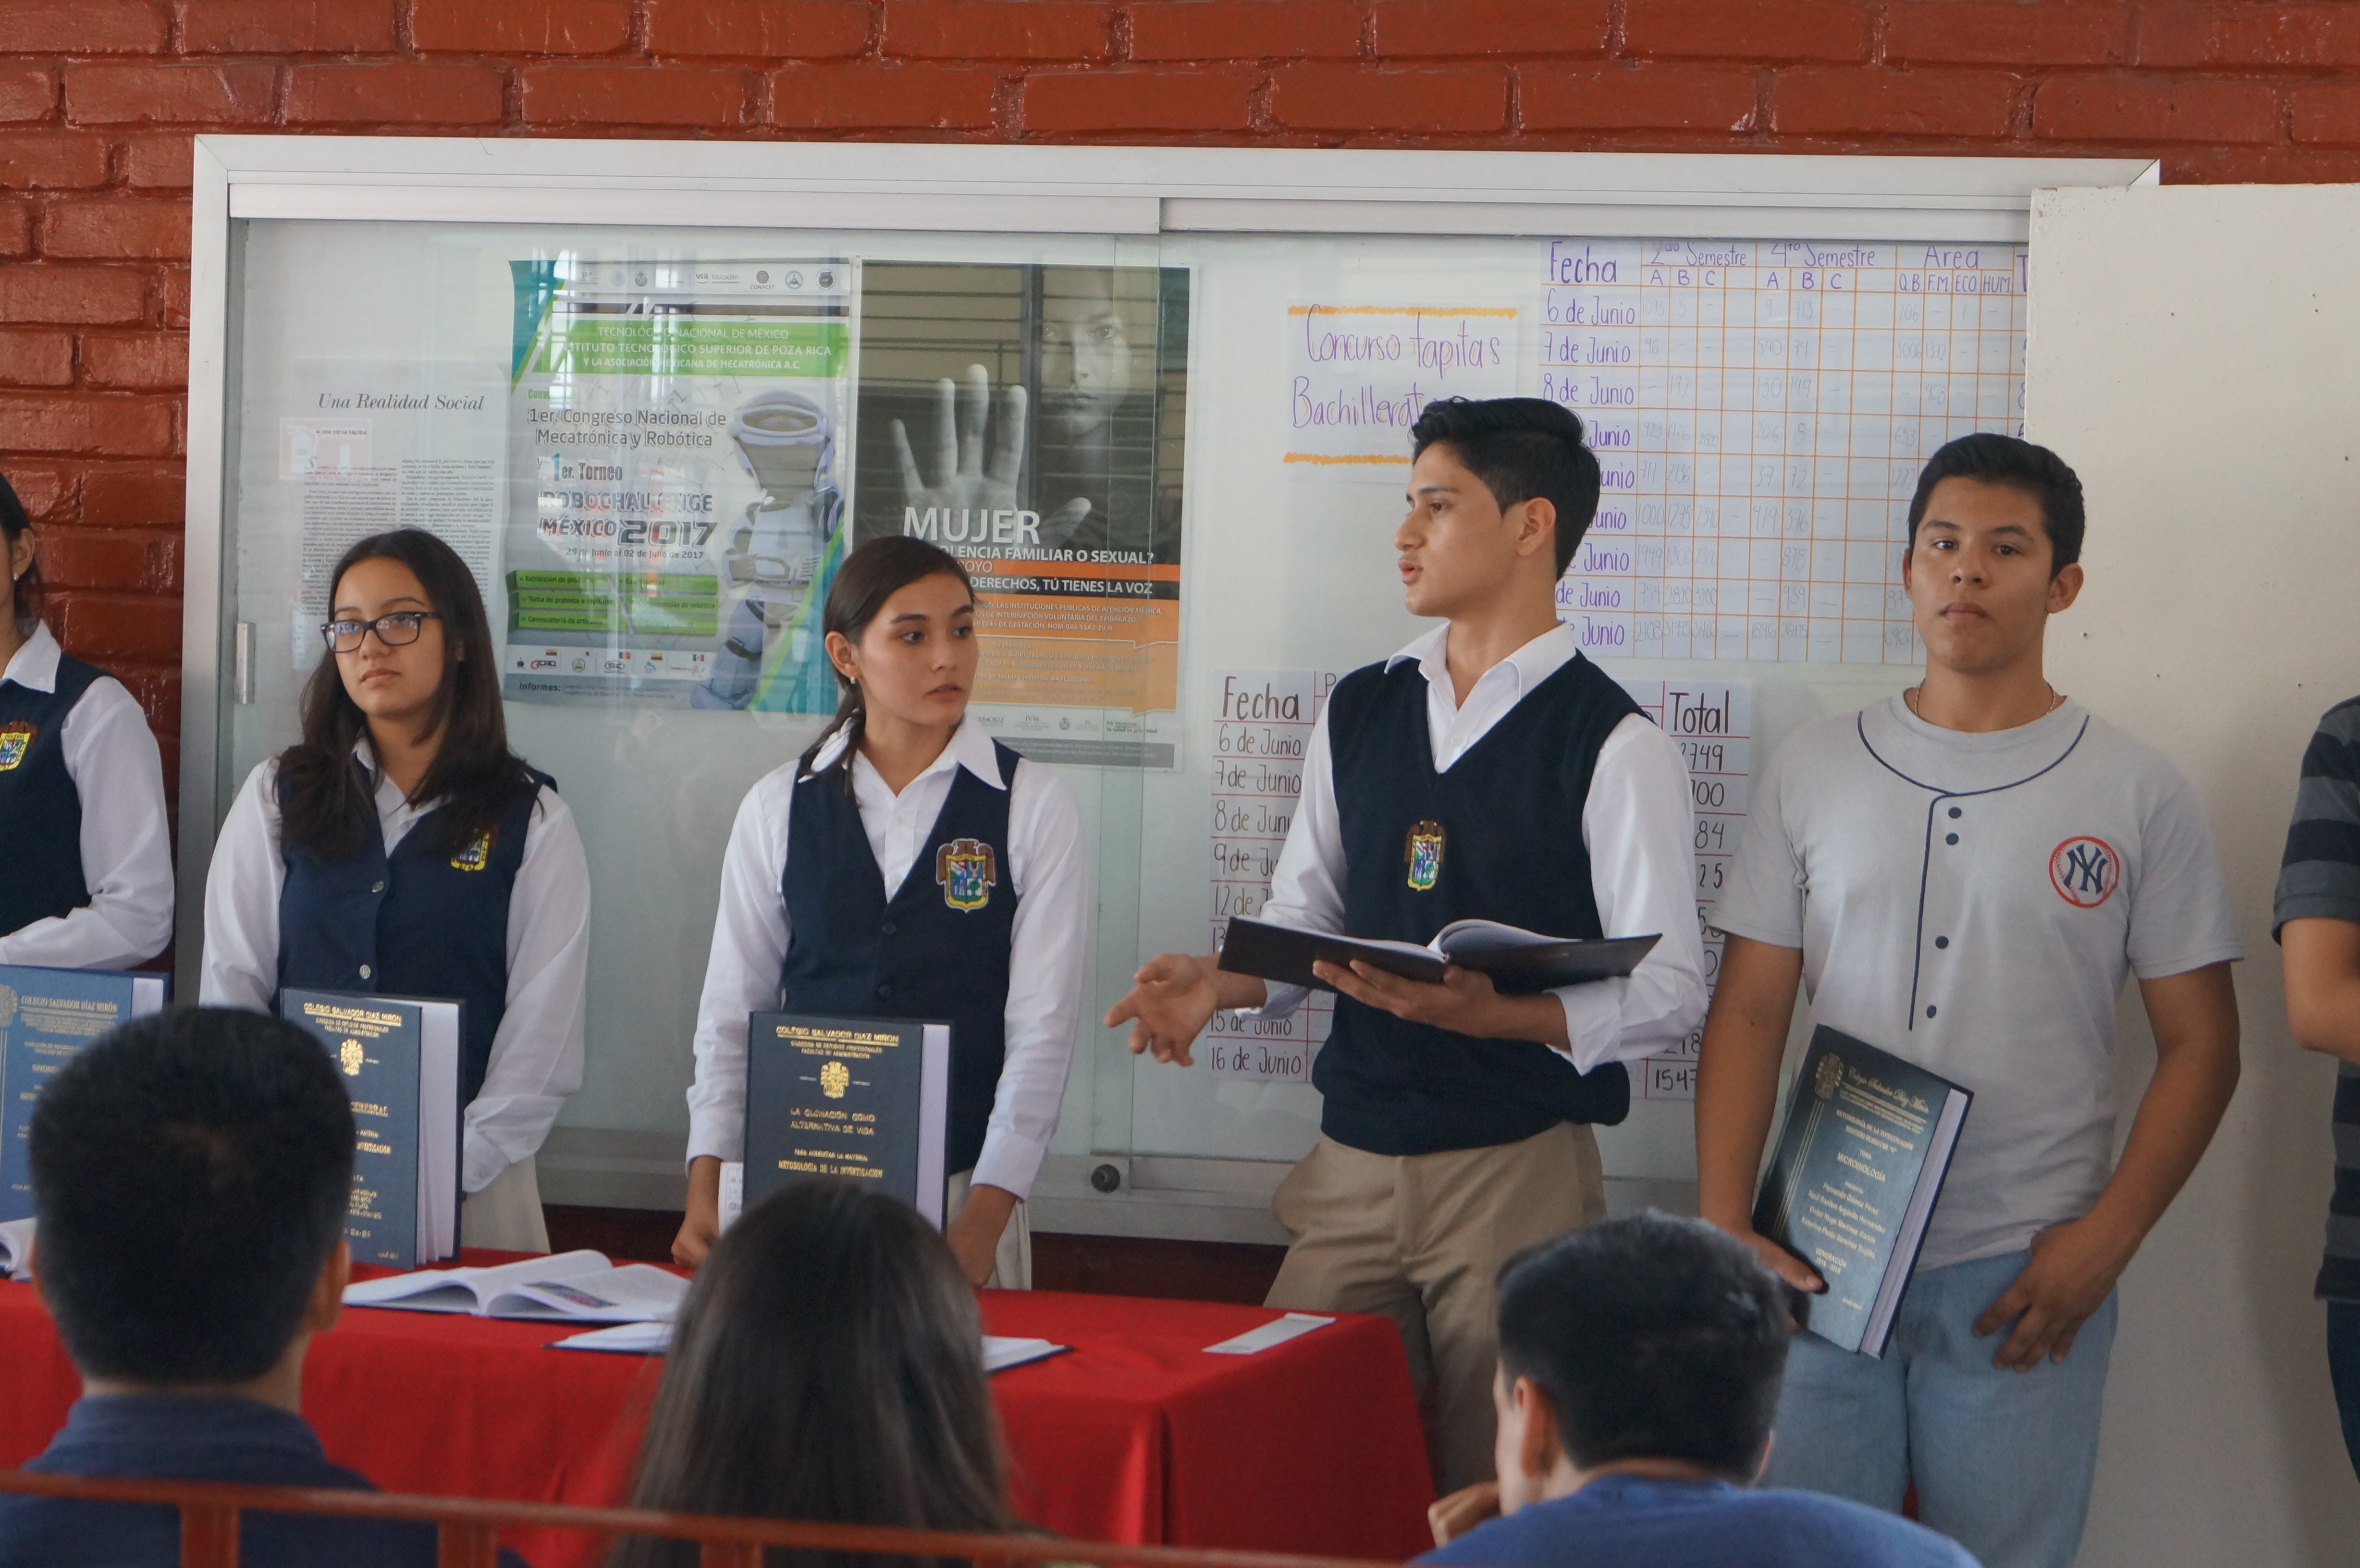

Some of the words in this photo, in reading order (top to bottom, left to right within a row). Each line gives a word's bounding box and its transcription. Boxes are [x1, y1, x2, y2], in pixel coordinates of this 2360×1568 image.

[1549, 242, 1617, 284] Fecha
[1685, 242, 1747, 267] Semestre
[1804, 243, 1876, 267] Semestre
[1924, 244, 1979, 270] Area
[1650, 268, 1663, 285] A
[1678, 269, 1690, 286] B
[1705, 270, 1716, 286] C
[1766, 271, 1780, 290] A
[1801, 271, 1814, 289] B
[1830, 272, 1842, 289] C
[1955, 274, 1977, 293] ECO
[1546, 288, 1559, 323] 6
[1565, 297, 1585, 324] de
[1590, 295, 1635, 326] Junio
[599, 326, 671, 337] TECNOLÓGCO
[675, 328, 728, 338] NACIONAL
[732, 329, 745, 338] DE
[748, 327, 788, 339] MÉXICO
[1306, 303, 1401, 362] Concurso
[1409, 310, 1500, 380] tapitas
[618, 342, 696, 354] TECNOÓGICO
[700, 344, 751, 355] SUPERIOR
[756, 346, 769, 355] DE
[773, 346, 802, 355] POZA
[806, 346, 831, 355] RICA
[1544, 331, 1553, 362] 7
[1559, 335, 1579, 363] de
[1586, 336, 1631, 364] Junio
[721, 359, 782, 369] MECATRÓNICA
[784, 361, 801, 369] A.C.
[1543, 372, 1554, 402] 8
[1559, 377, 1579, 403] de
[1589, 376, 1635, 405] Junio
[318, 393, 350, 408] Una
[355, 393, 430, 409] Realidad
[434, 394, 485, 410] Social
[1292, 375, 1437, 428] Bachillerat
[529, 408, 558, 424] 1er.
[561, 409, 632, 428] Congreso
[635, 409, 702, 425] Nacional
[706, 411, 726, 426] de
[535, 429, 627, 445] Mecatrónica
[630, 435, 641, 448] y
[645, 430, 712, 446] Robótica
[1588, 419, 1631, 449] Junio
[537, 456, 543, 469] y
[578, 462, 622, 481] Torneo
[539, 514, 617, 537] MÉXICO
[618, 519, 718, 546] 2017
[903, 506, 1041, 545] MUJER
[1587, 507, 1627, 530] unio
[624, 549, 634, 557] 02
[637, 549, 647, 557] de
[941, 545, 1001, 560] OLENCIA
[1005, 547, 1072, 561] FAMILIAR
[1076, 550, 1088, 562] O
[1091, 551, 1154, 564] SEXUAL?
[1583, 541, 1630, 572] Junio
[958, 561, 993, 573] OYO
[970, 576, 1040, 590] DERECHOS,
[1043, 576, 1058, 590] TÚ
[1062, 579, 1104, 591] TIENES
[1107, 581, 1123, 592] LA
[1126, 582, 1153, 594] VOZ
[1555, 580, 1574, 605] de
[1579, 581, 1621, 608] Junio
[1581, 616, 1625, 647] Junio
[1222, 674, 1300, 721] Fecha
[1668, 688, 1730, 735] Total
[1218, 723, 1230, 752] 6
[1237, 726, 1255, 754] de
[1260, 728, 1302, 757] Junio
[1215, 759, 1225, 786] 7
[1227, 763, 1247, 789] de
[1256, 763, 1303, 794] Junio
[1214, 799, 1226, 832] 8
[1230, 806, 1250, 833] de
[1256, 804, 1291, 833] Juni
[1694, 820, 1725, 849] 84
[1213, 842, 1227, 875] 9
[1229, 847, 1250, 872] de
[2063, 843, 2108, 895] NY
[1215, 885, 1230, 917] 12
[1233, 887, 1254, 916] de
[49, 998, 80, 1009] SALVADOR
[1210, 1009, 1226, 1033] 15
[811, 1028, 852, 1039] SALVADOR
[873, 1033, 899, 1043] MIRON
[1211, 1045, 1226, 1071] 16
[1232, 1045, 1250, 1072] de
[1257, 1046, 1302, 1076] Junio
